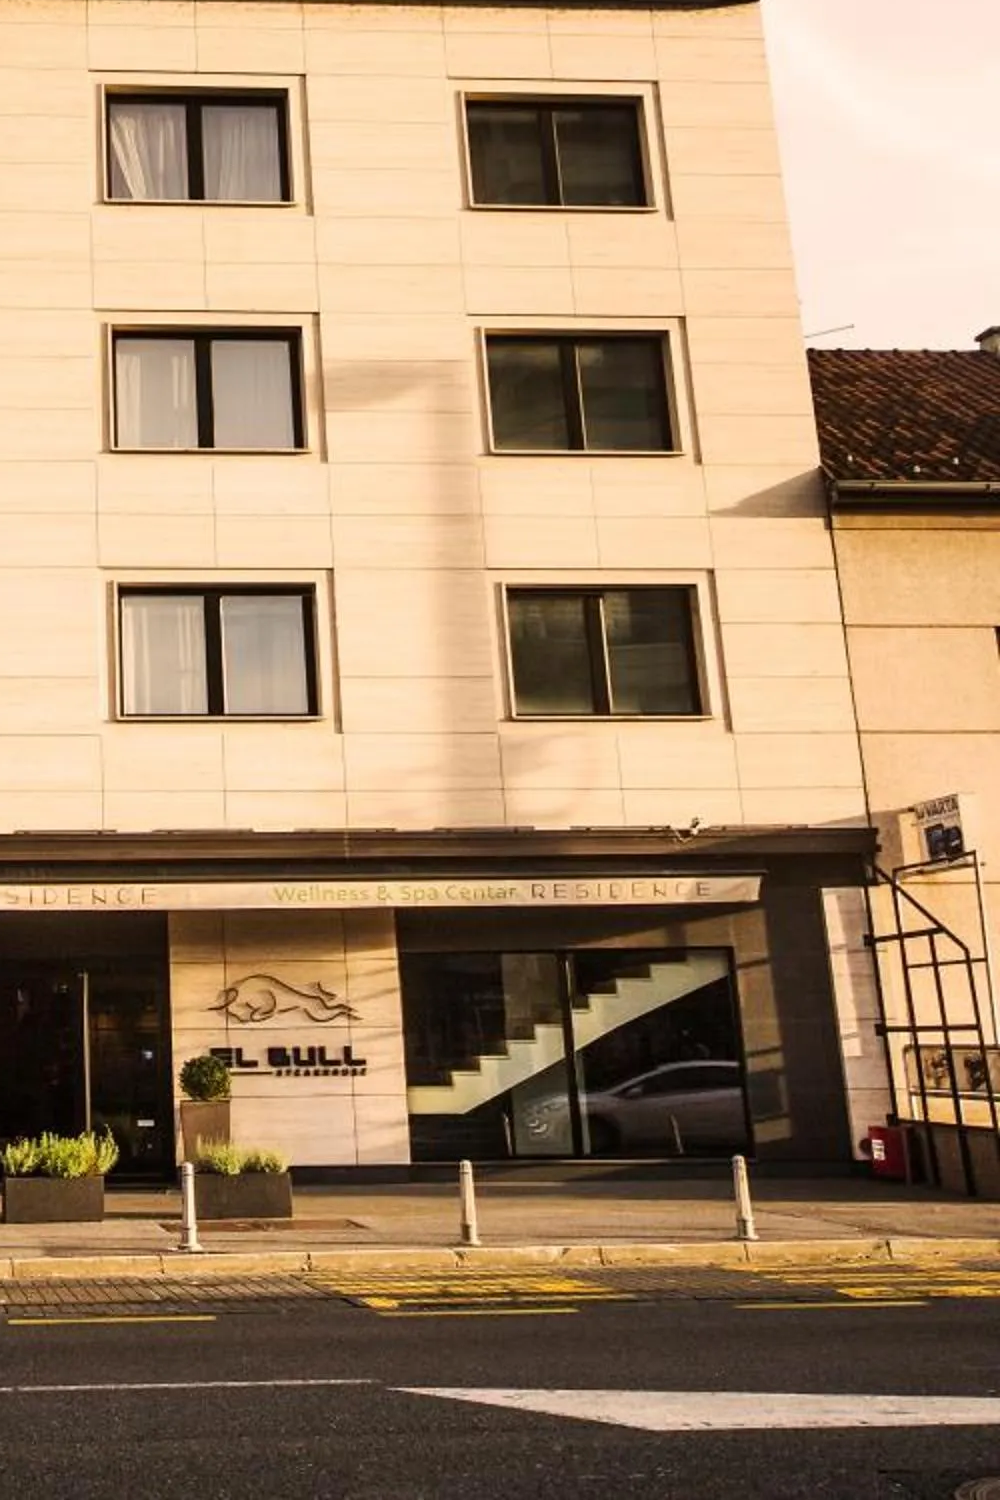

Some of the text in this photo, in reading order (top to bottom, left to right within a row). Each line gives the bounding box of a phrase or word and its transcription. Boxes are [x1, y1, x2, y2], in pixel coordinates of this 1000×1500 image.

[273, 884, 370, 903] Wellness
[376, 885, 393, 901] &
[400, 884, 439, 904] Spa
[530, 881, 713, 899] RESIDENCE
[209, 1045, 368, 1068] EL BULL
